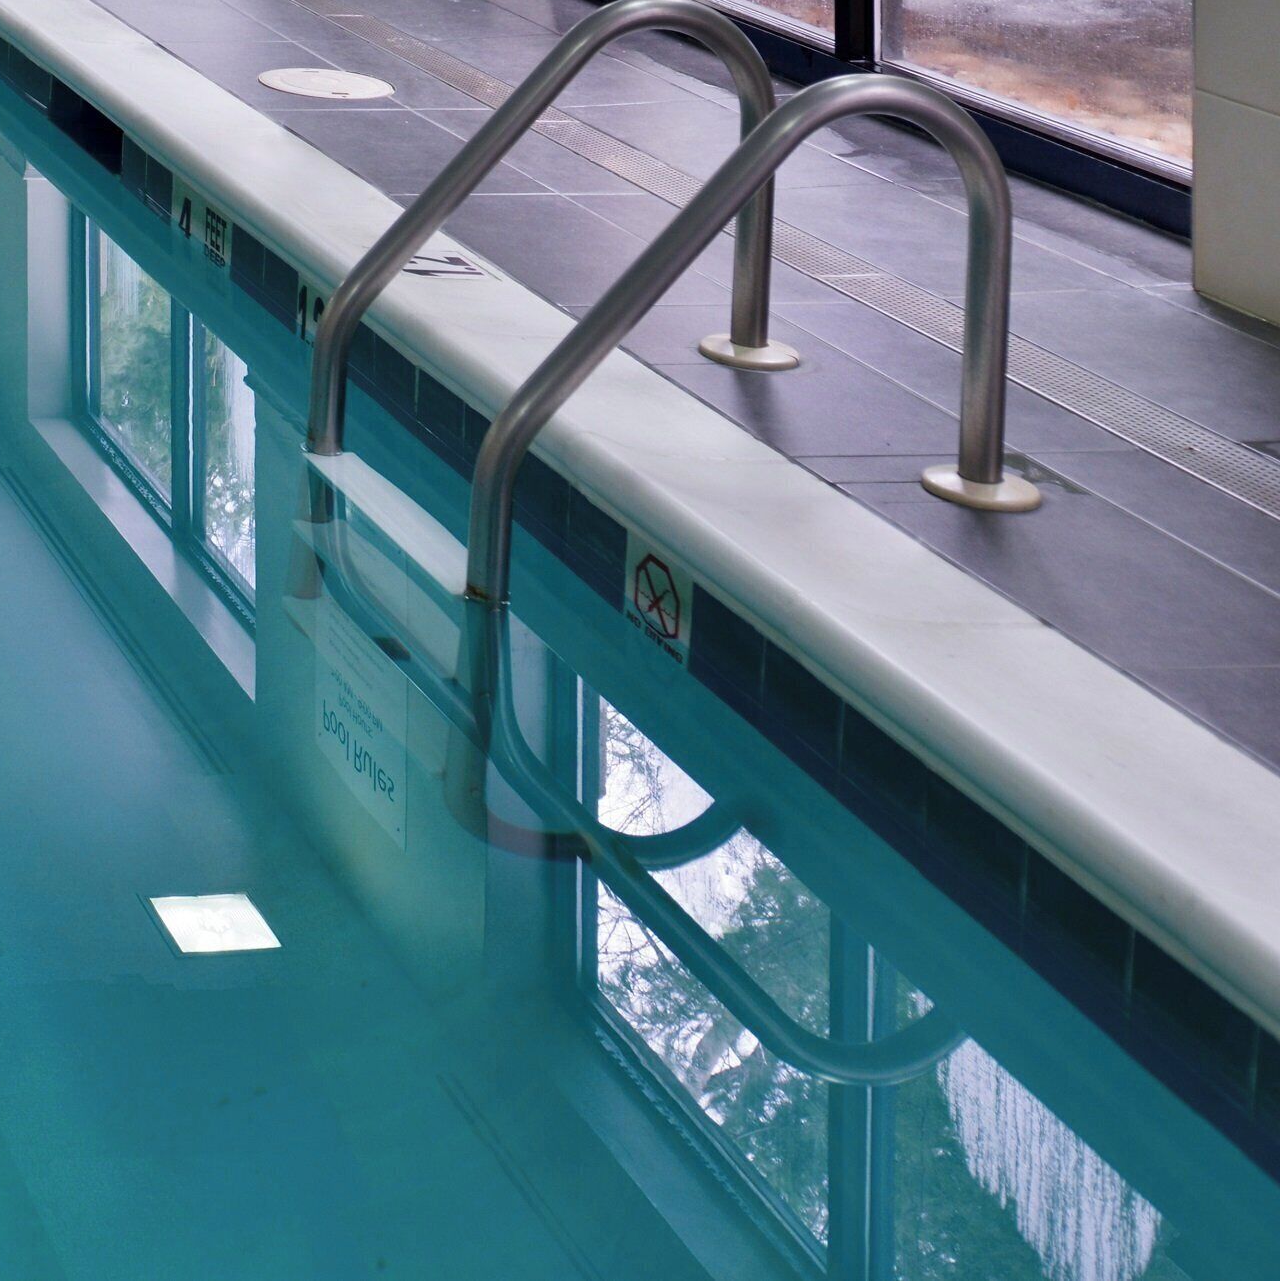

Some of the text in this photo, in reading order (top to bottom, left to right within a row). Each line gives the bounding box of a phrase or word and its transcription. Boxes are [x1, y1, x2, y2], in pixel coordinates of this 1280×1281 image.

[178, 197, 227, 256] 4 FEET
[204, 243, 226, 268] DEEP
